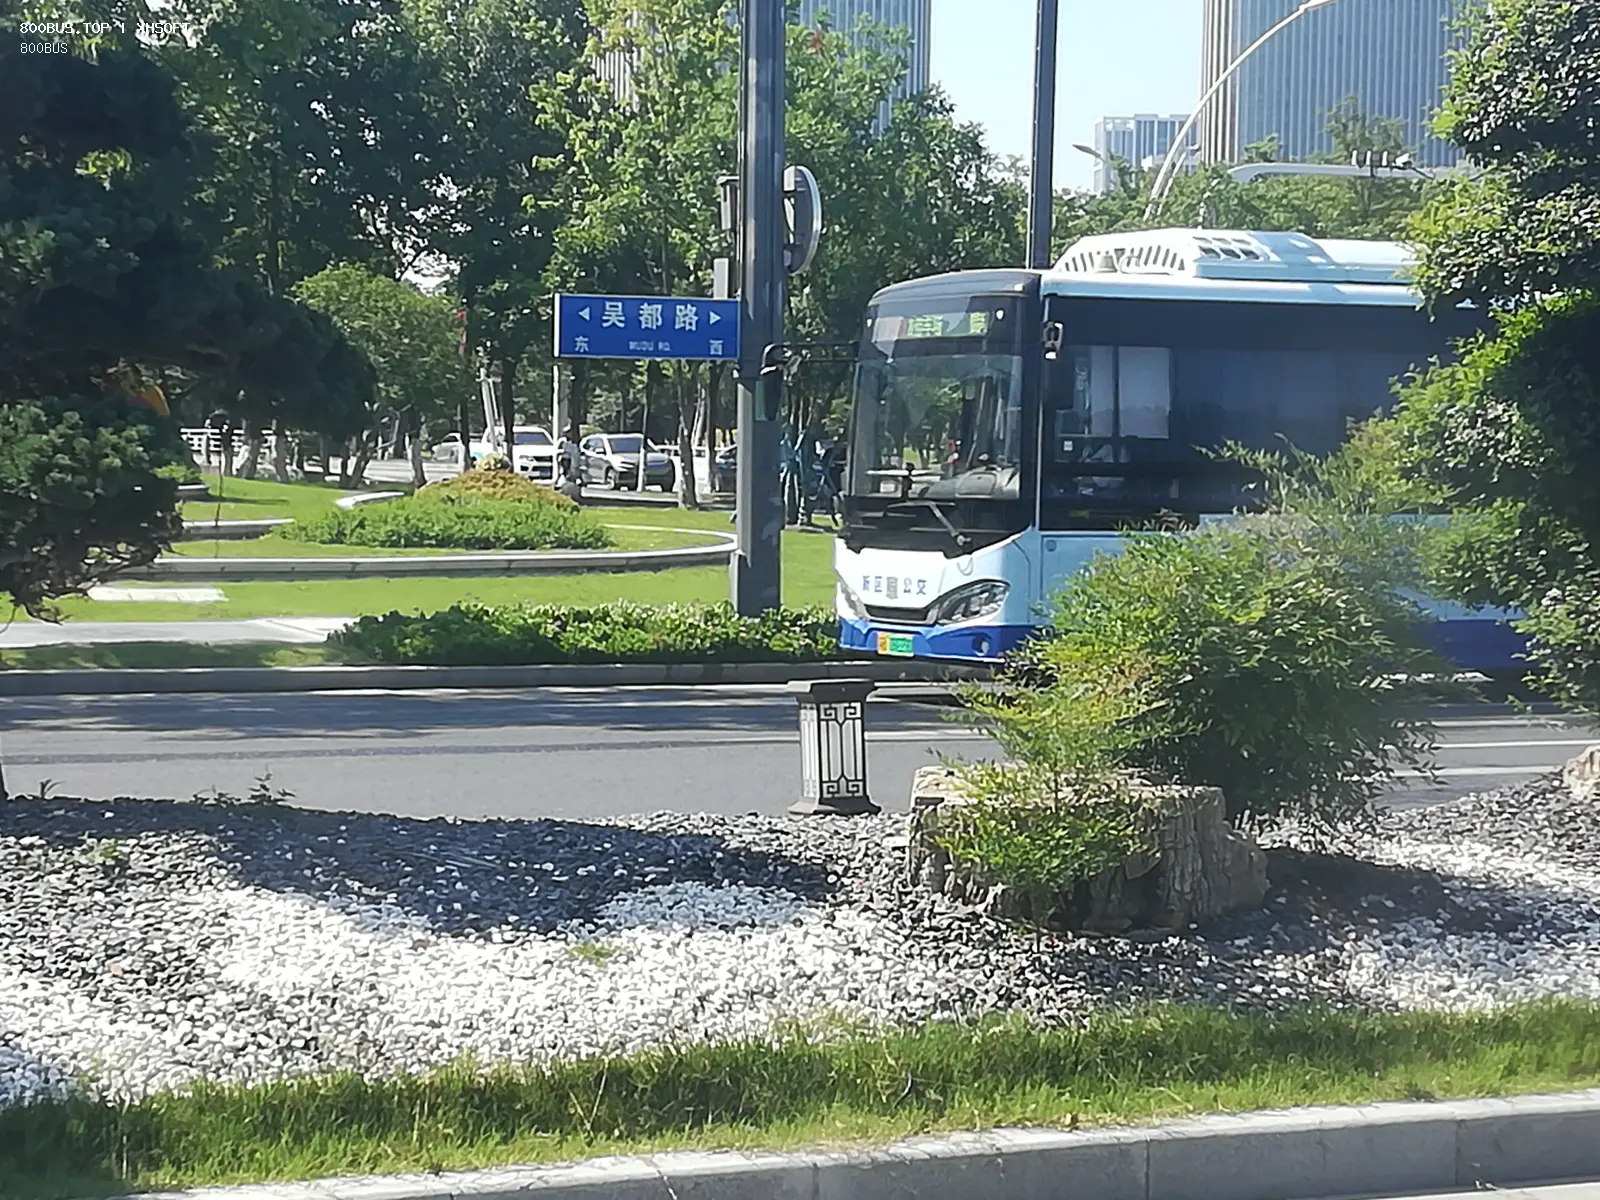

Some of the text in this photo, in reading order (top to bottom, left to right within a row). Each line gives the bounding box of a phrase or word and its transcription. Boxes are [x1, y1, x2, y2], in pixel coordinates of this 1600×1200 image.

[602, 301, 699, 332] 吴都路
[574, 336, 590, 353] 东
[709, 340, 724, 356] 西
